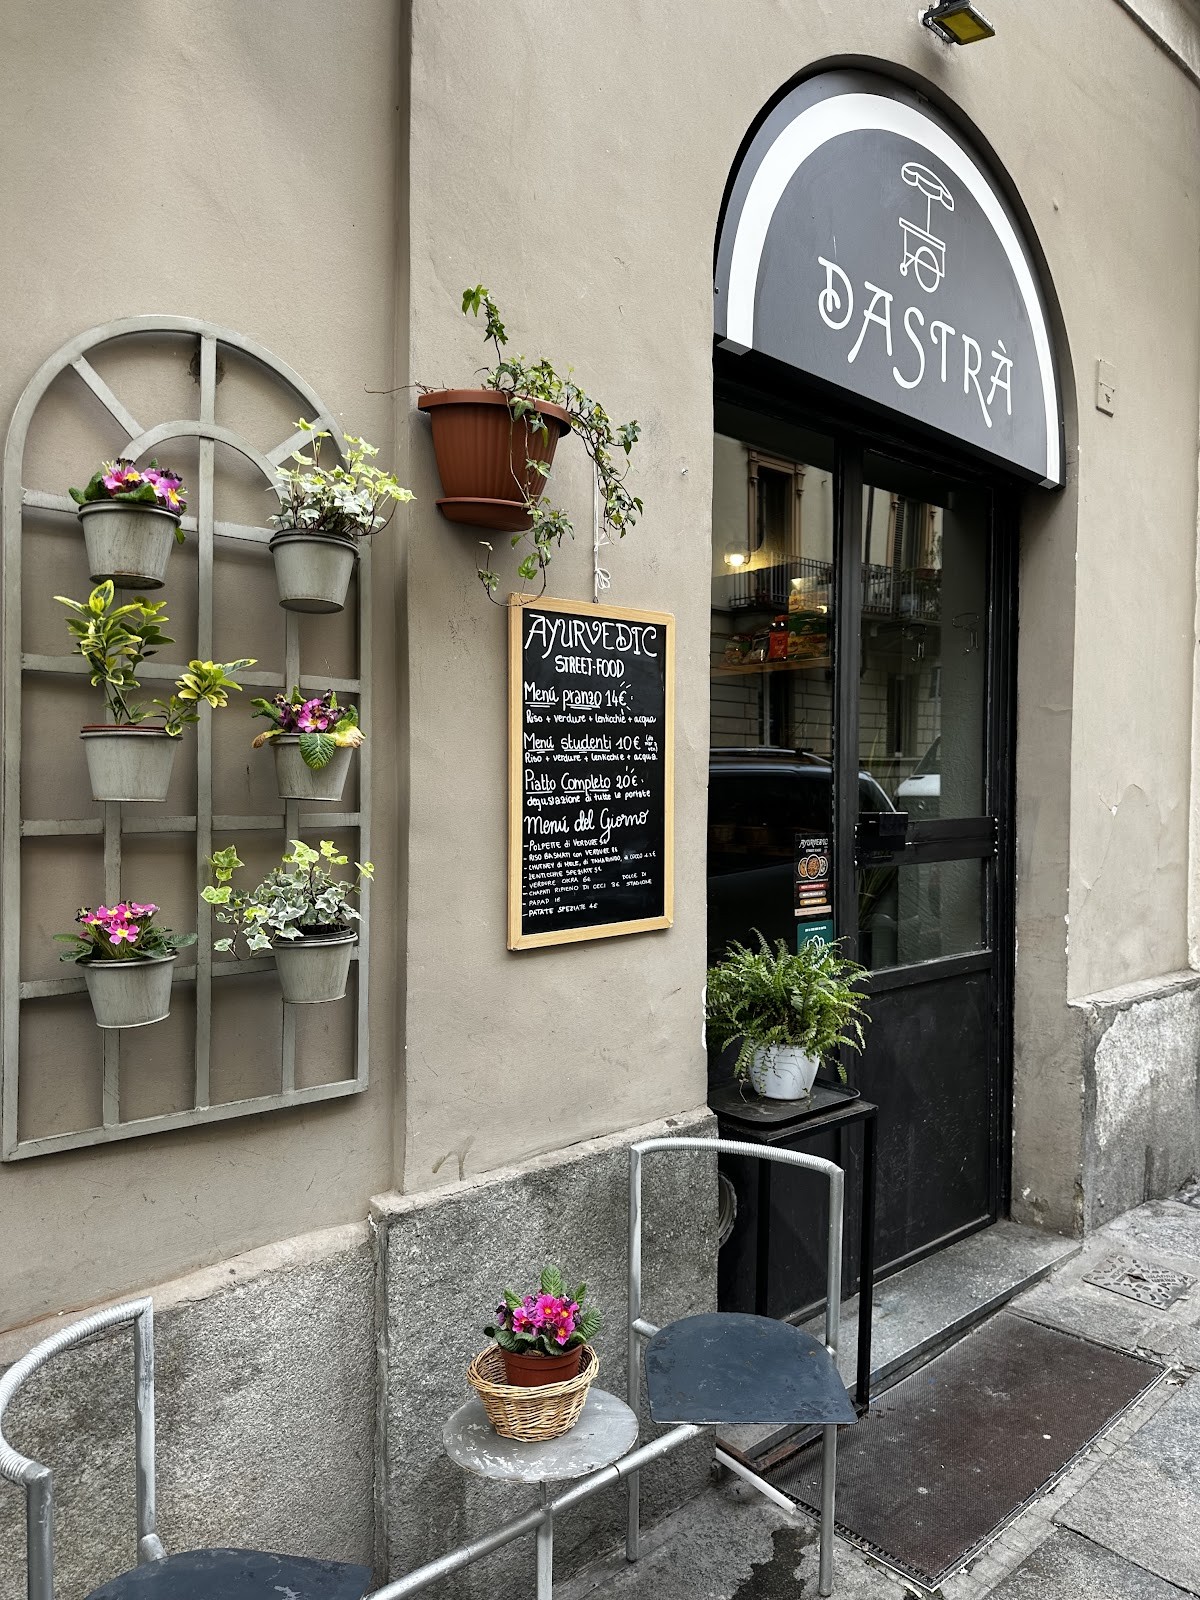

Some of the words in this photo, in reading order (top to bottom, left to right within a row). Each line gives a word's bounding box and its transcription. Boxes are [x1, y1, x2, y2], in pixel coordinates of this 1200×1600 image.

[818, 256, 1013, 428] DASTRÀ
[524, 614, 657, 659] AYURVEDIC
[555, 655, 624, 678] STREET-FOOD
[524, 681, 559, 703] Menú
[563, 689, 602, 711] pranzo
[605, 689, 627, 707] 14€
[526, 709, 543, 724] Riso
[554, 713, 586, 724] verdure
[595, 713, 626, 724] lenticchie
[634, 715, 656, 727] acqua
[524, 732, 554, 750] Menú
[561, 734, 612, 750] studenti
[525, 752, 542, 764] Riso
[553, 753, 582, 762] verdure
[591, 752, 625, 762] lenticchie
[525, 768, 556, 791] Piatto
[561, 772, 611, 796] Completo
[527, 795, 580, 811] degustazione
[585, 794, 592, 802] di
[594, 793, 612, 801] tutte
[625, 790, 650, 800] portate
[524, 816, 570, 834] Menú
[574, 809, 595, 832] del
[600, 808, 650, 844] Giorno
[564, 840, 570, 848] di
[573, 838, 598, 847] VERDURE
[529, 898, 550, 906] PAPAD
